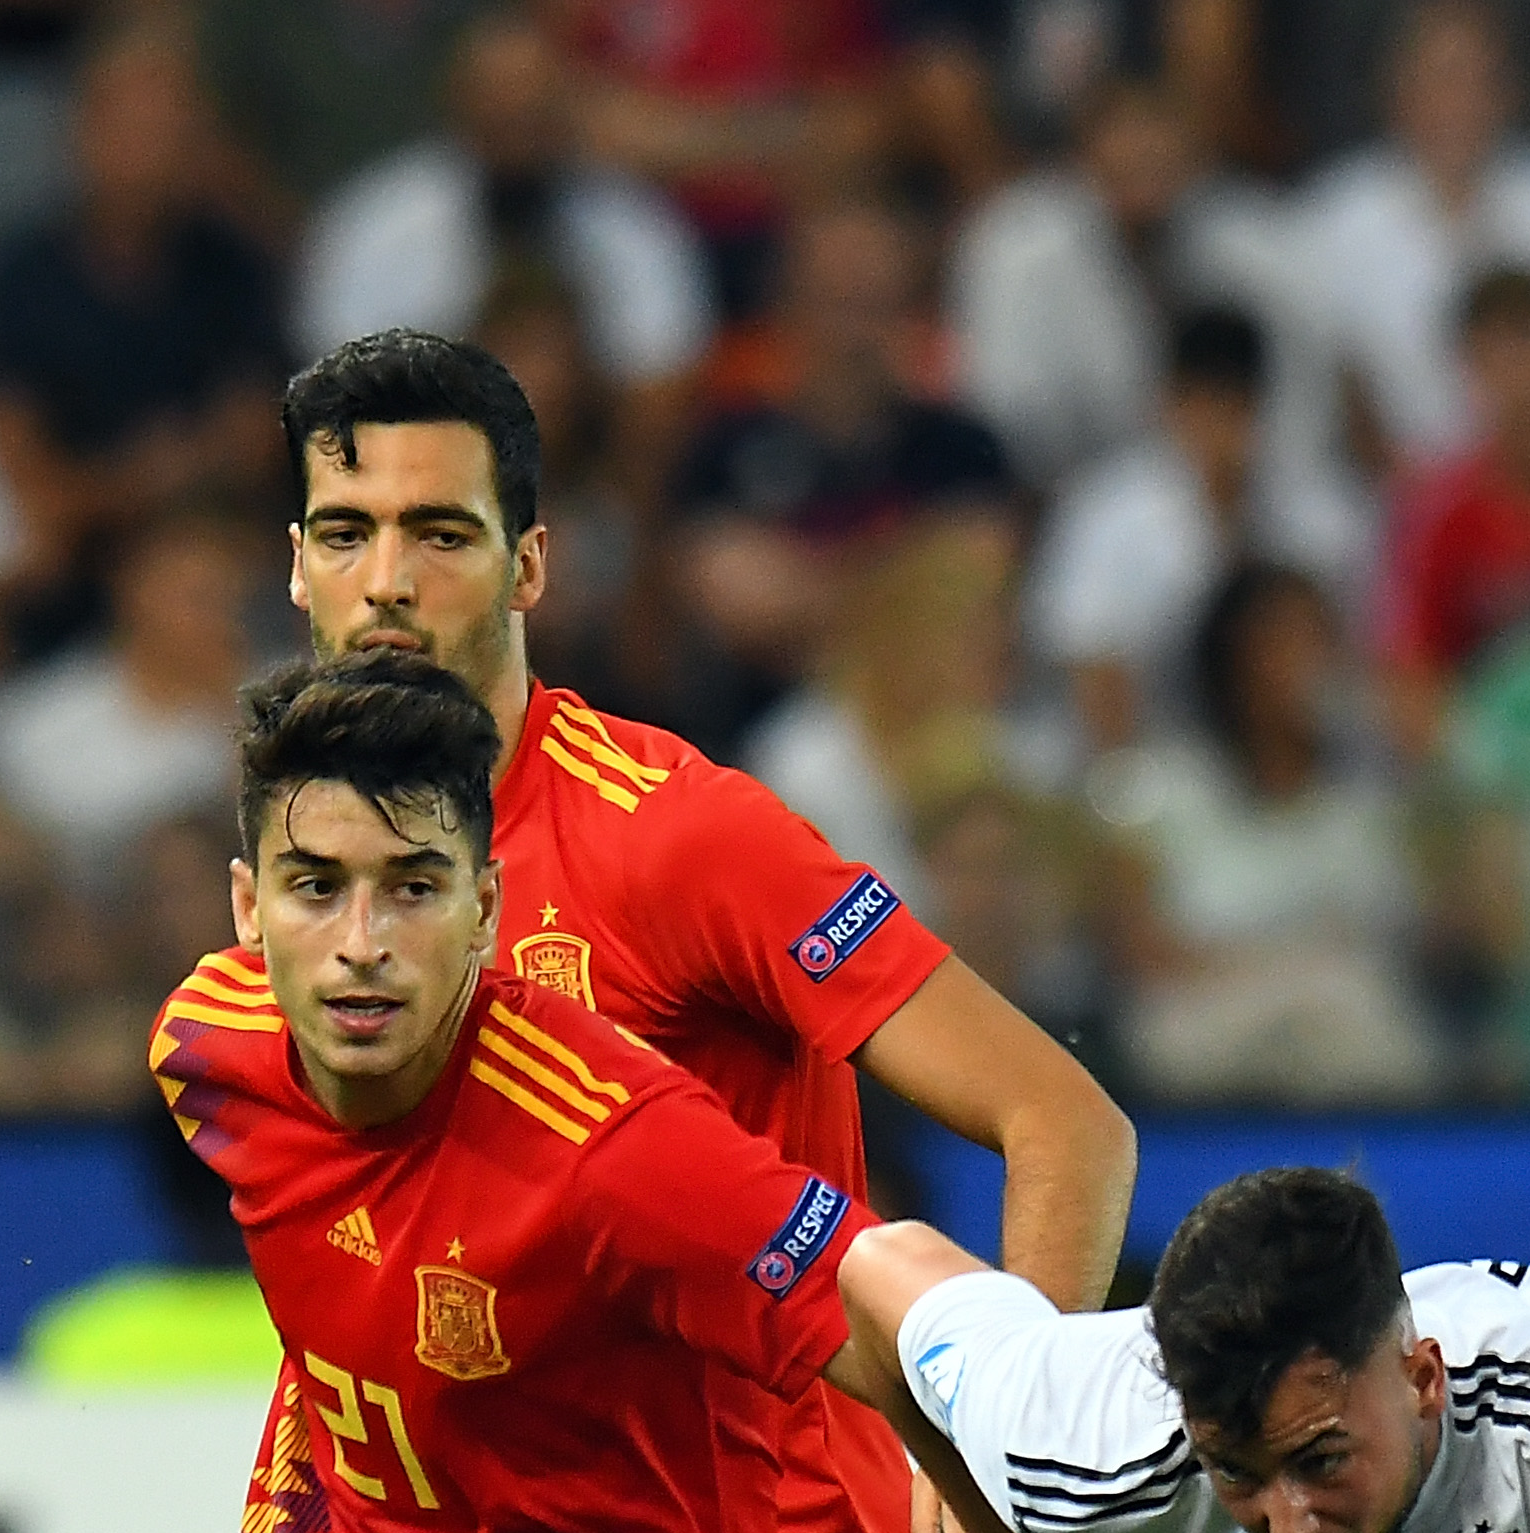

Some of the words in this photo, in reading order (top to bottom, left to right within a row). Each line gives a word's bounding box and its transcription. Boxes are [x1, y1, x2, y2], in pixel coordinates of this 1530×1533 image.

[827, 880, 888, 946] RESPECT
[326, 1229, 382, 1266] adidas
[783, 1183, 838, 1258] RESPECT
[304, 1350, 441, 1510] 21
